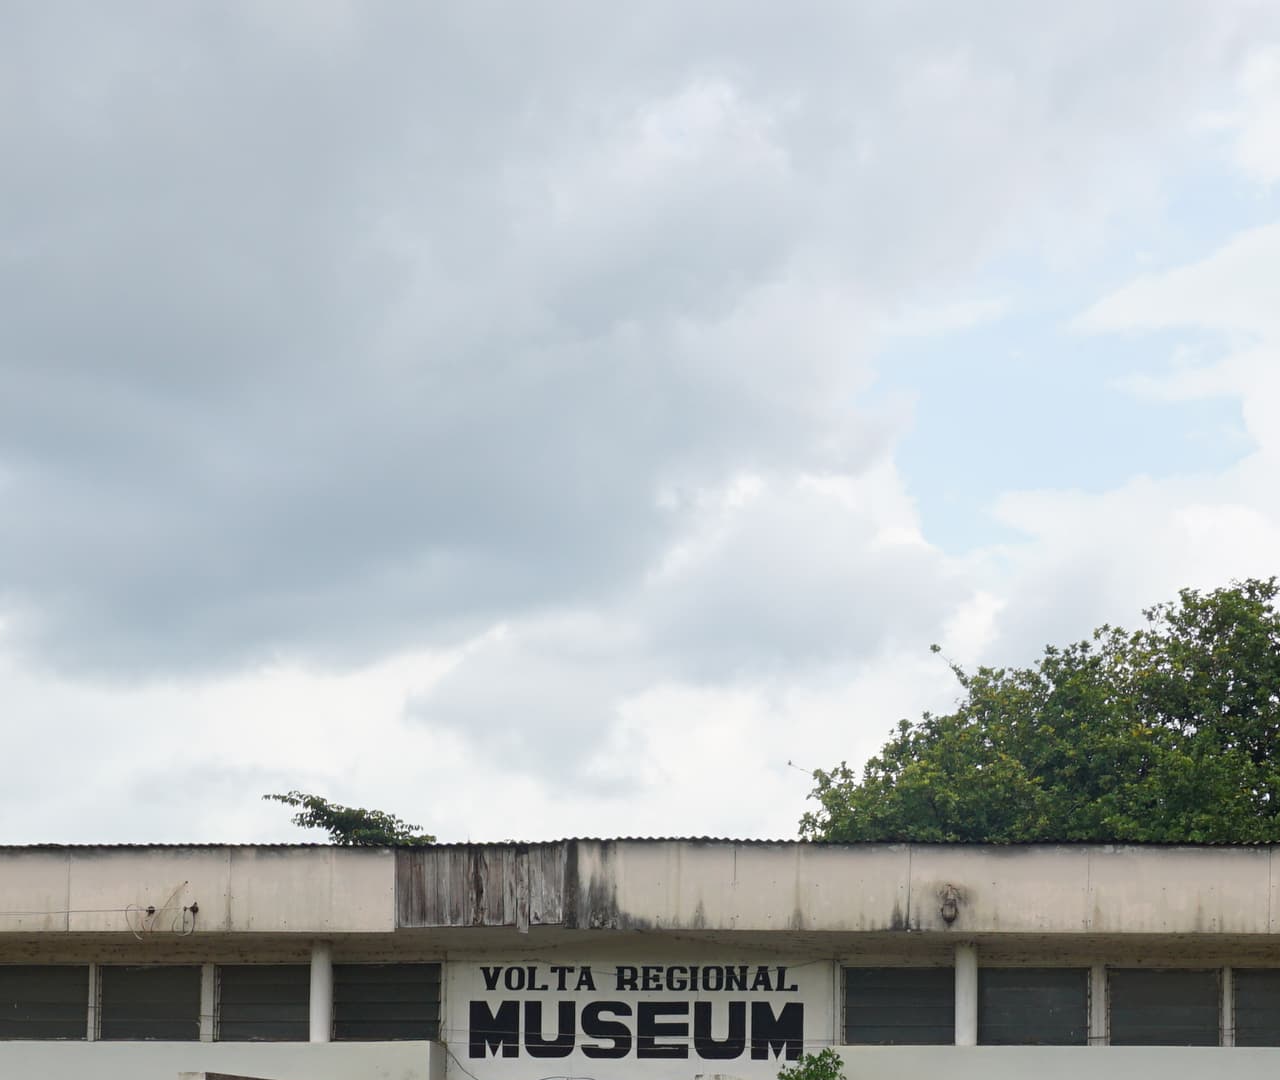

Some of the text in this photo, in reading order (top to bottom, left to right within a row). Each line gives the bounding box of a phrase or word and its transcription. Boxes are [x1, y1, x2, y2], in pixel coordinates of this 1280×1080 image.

[480, 966, 799, 992] VOLTA REGIONAL
[469, 1000, 804, 1060] MUSEUM
